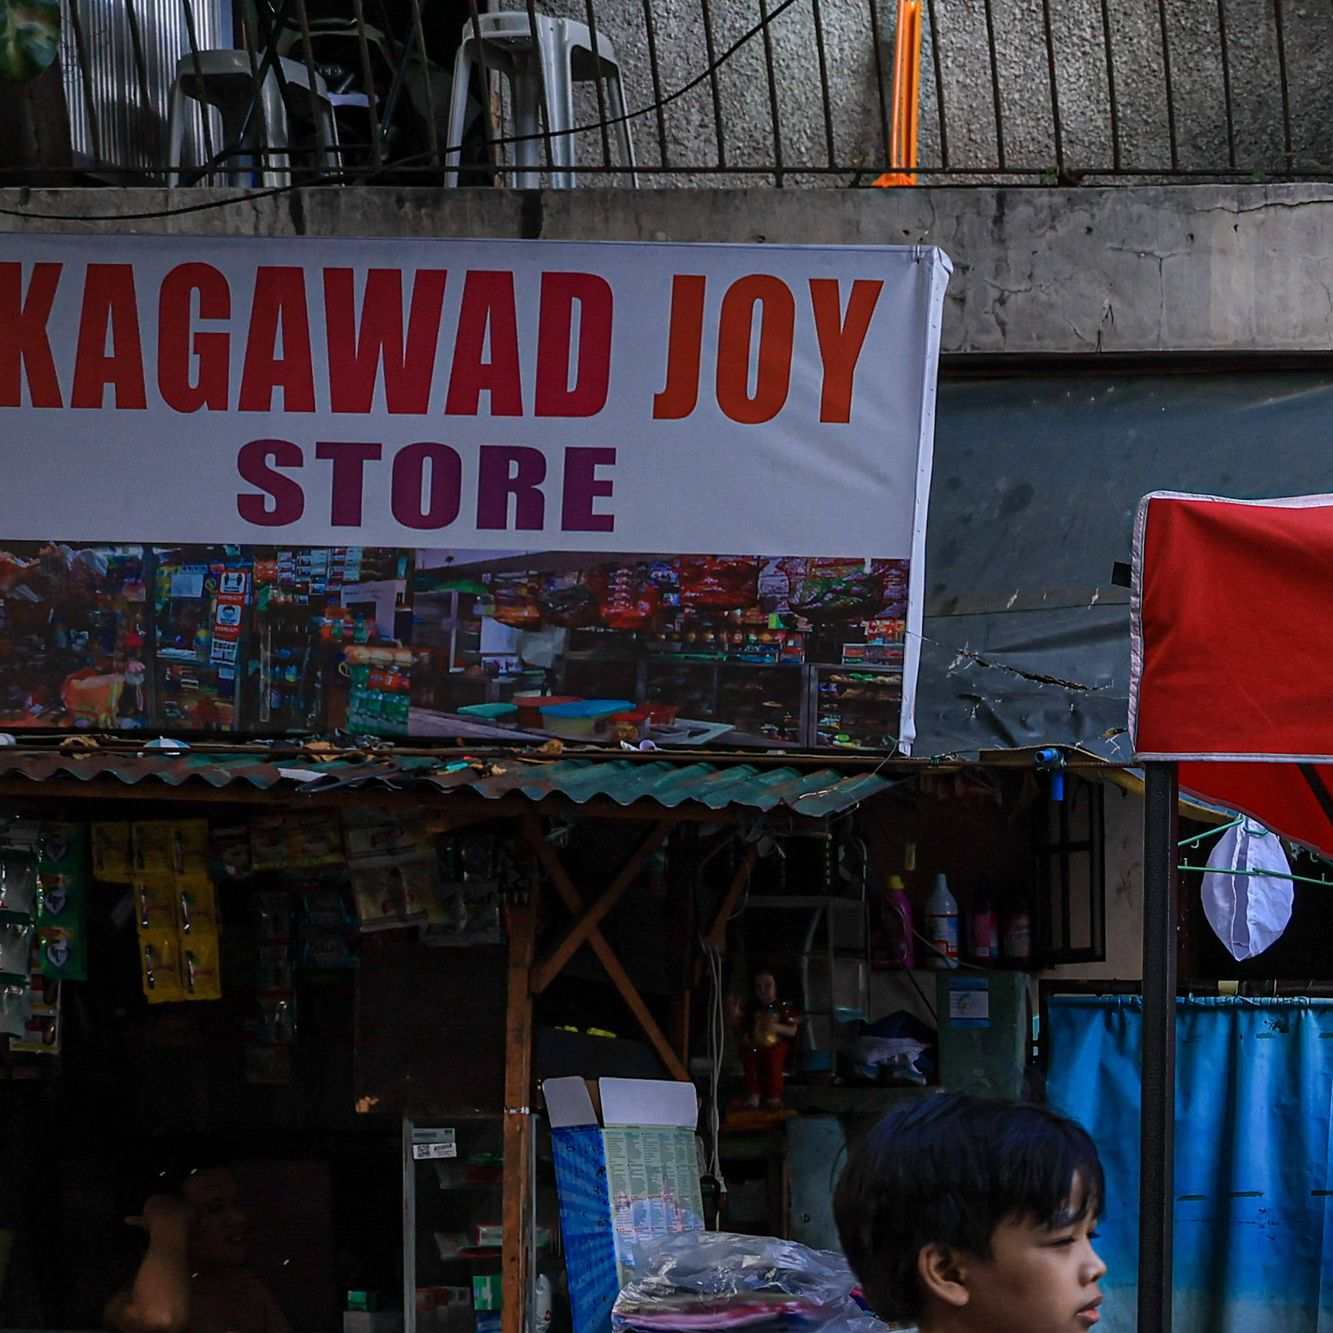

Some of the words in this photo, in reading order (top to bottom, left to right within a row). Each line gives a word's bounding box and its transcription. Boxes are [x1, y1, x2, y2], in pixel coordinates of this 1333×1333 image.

[0, 261, 613, 418] KAGAWAD
[652, 273, 884, 425] JOY
[236, 437, 618, 532] STORE
